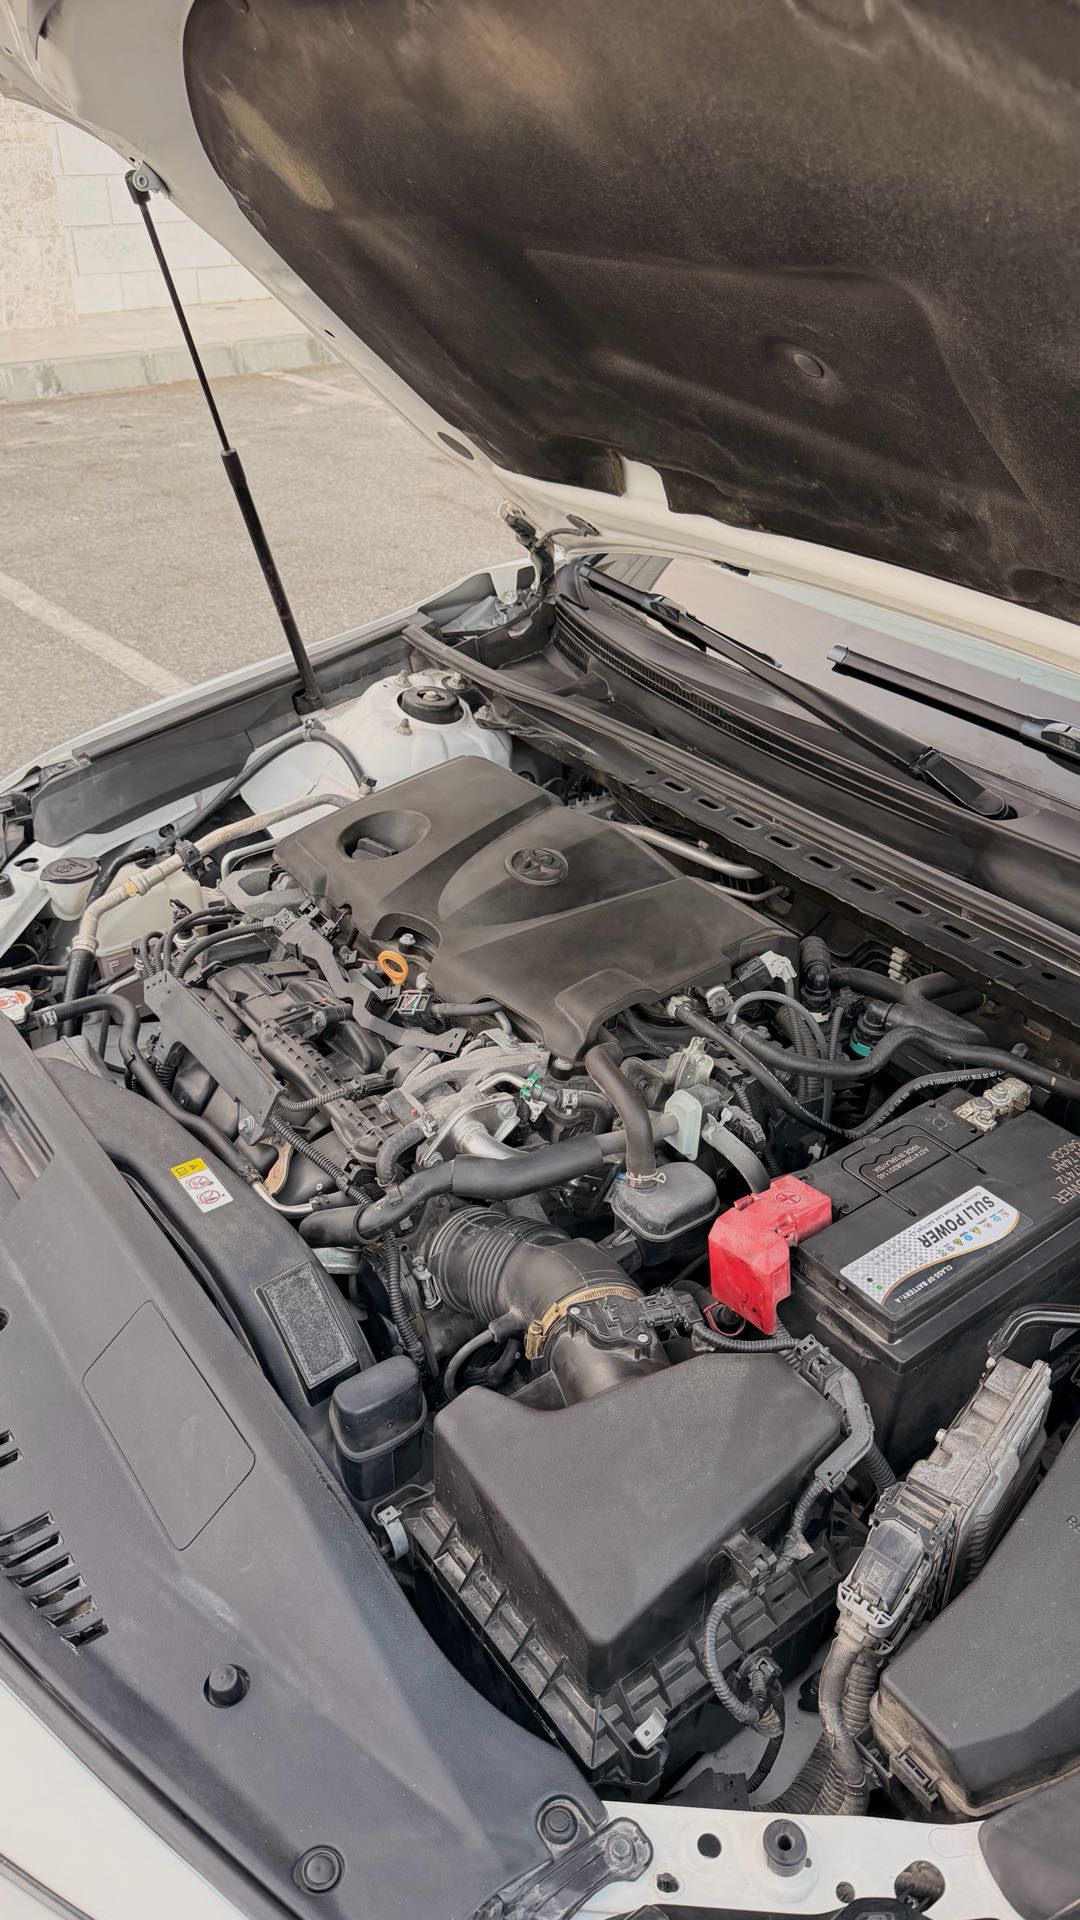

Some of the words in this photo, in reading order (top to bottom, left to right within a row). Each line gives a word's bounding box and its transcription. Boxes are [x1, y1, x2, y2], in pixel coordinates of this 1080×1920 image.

[903, 1144, 921, 1156] MADE
[872, 1156, 900, 1173] MALAYSIA
[962, 1195, 995, 1221] SULI
[917, 1213, 967, 1248] POWER
[934, 1264, 953, 1279] CLASS
[927, 1276, 936, 1284] OF
